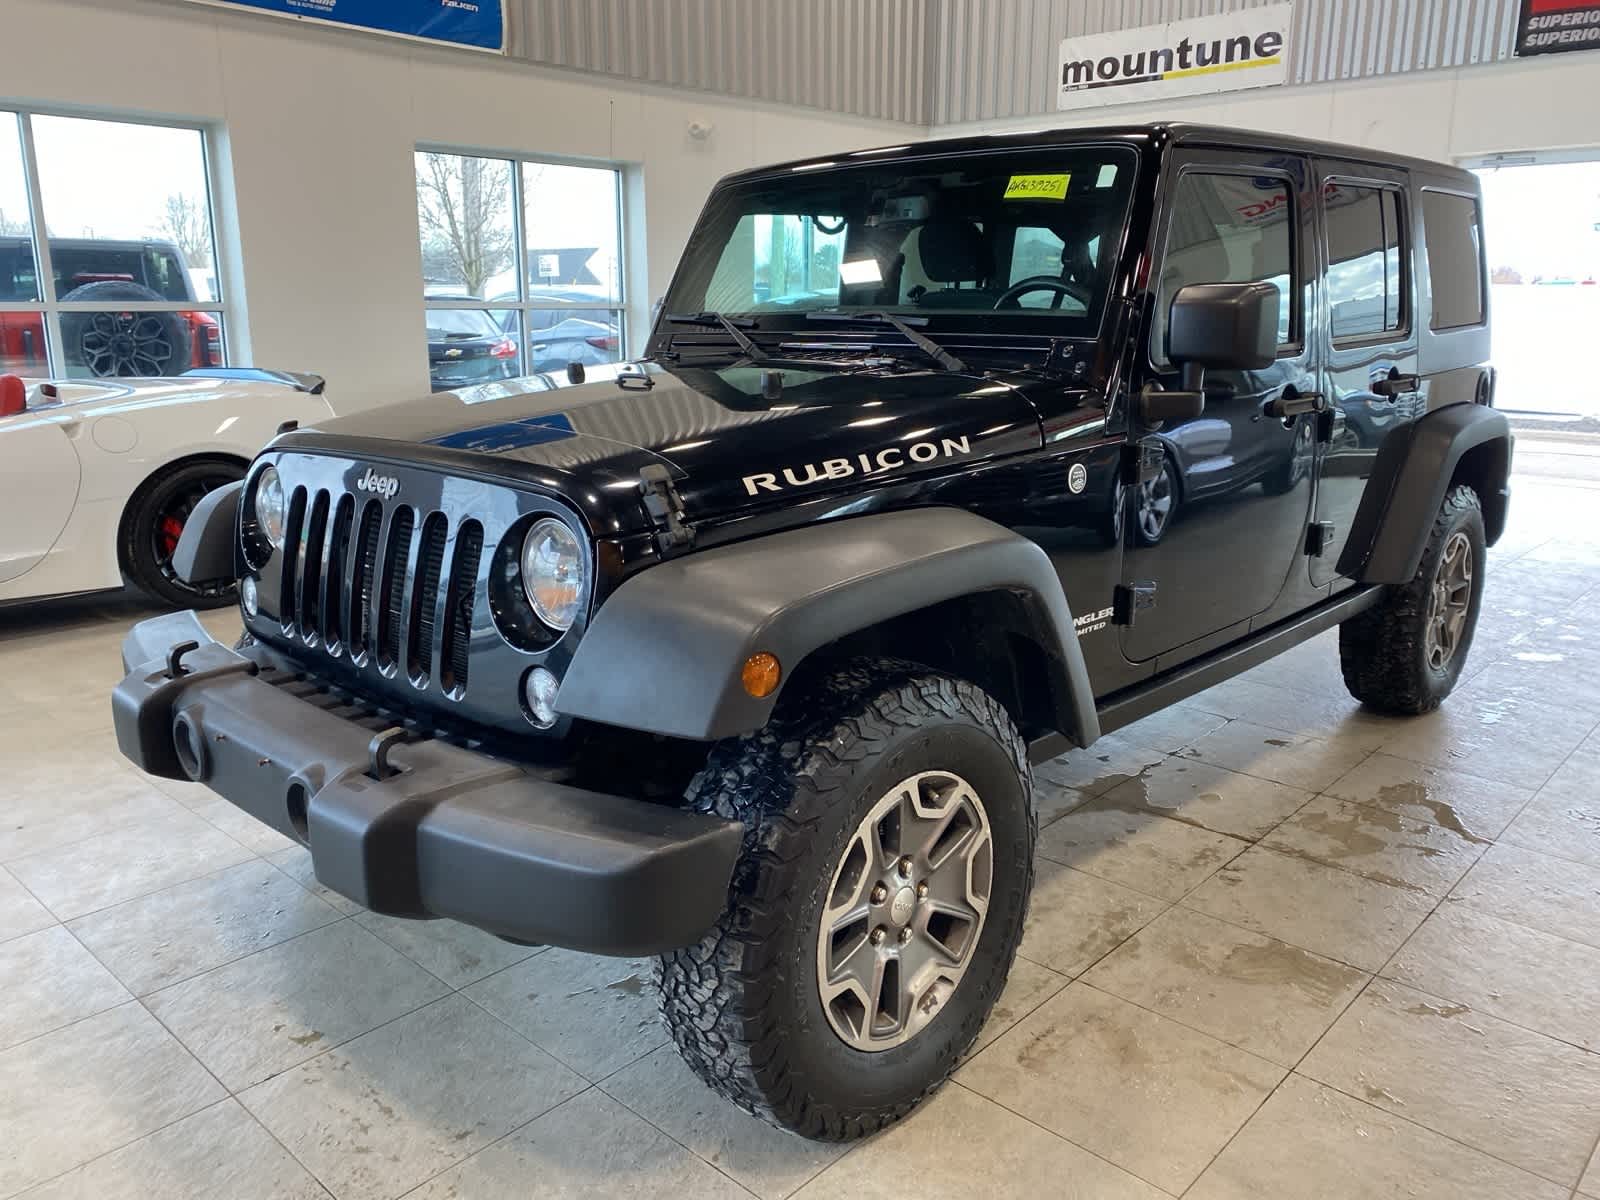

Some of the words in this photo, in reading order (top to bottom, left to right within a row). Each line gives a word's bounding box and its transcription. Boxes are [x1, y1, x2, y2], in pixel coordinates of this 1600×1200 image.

[1527, 10, 1600, 30] SUPERIO
[1525, 27, 1600, 47] SUPERIO
[1062, 31, 1283, 85] mountune
[742, 435, 971, 496] RUBICON
[357, 468, 399, 500] Jeep
[1073, 606, 1114, 627] NGLER
[1077, 621, 1106, 636] MITED
